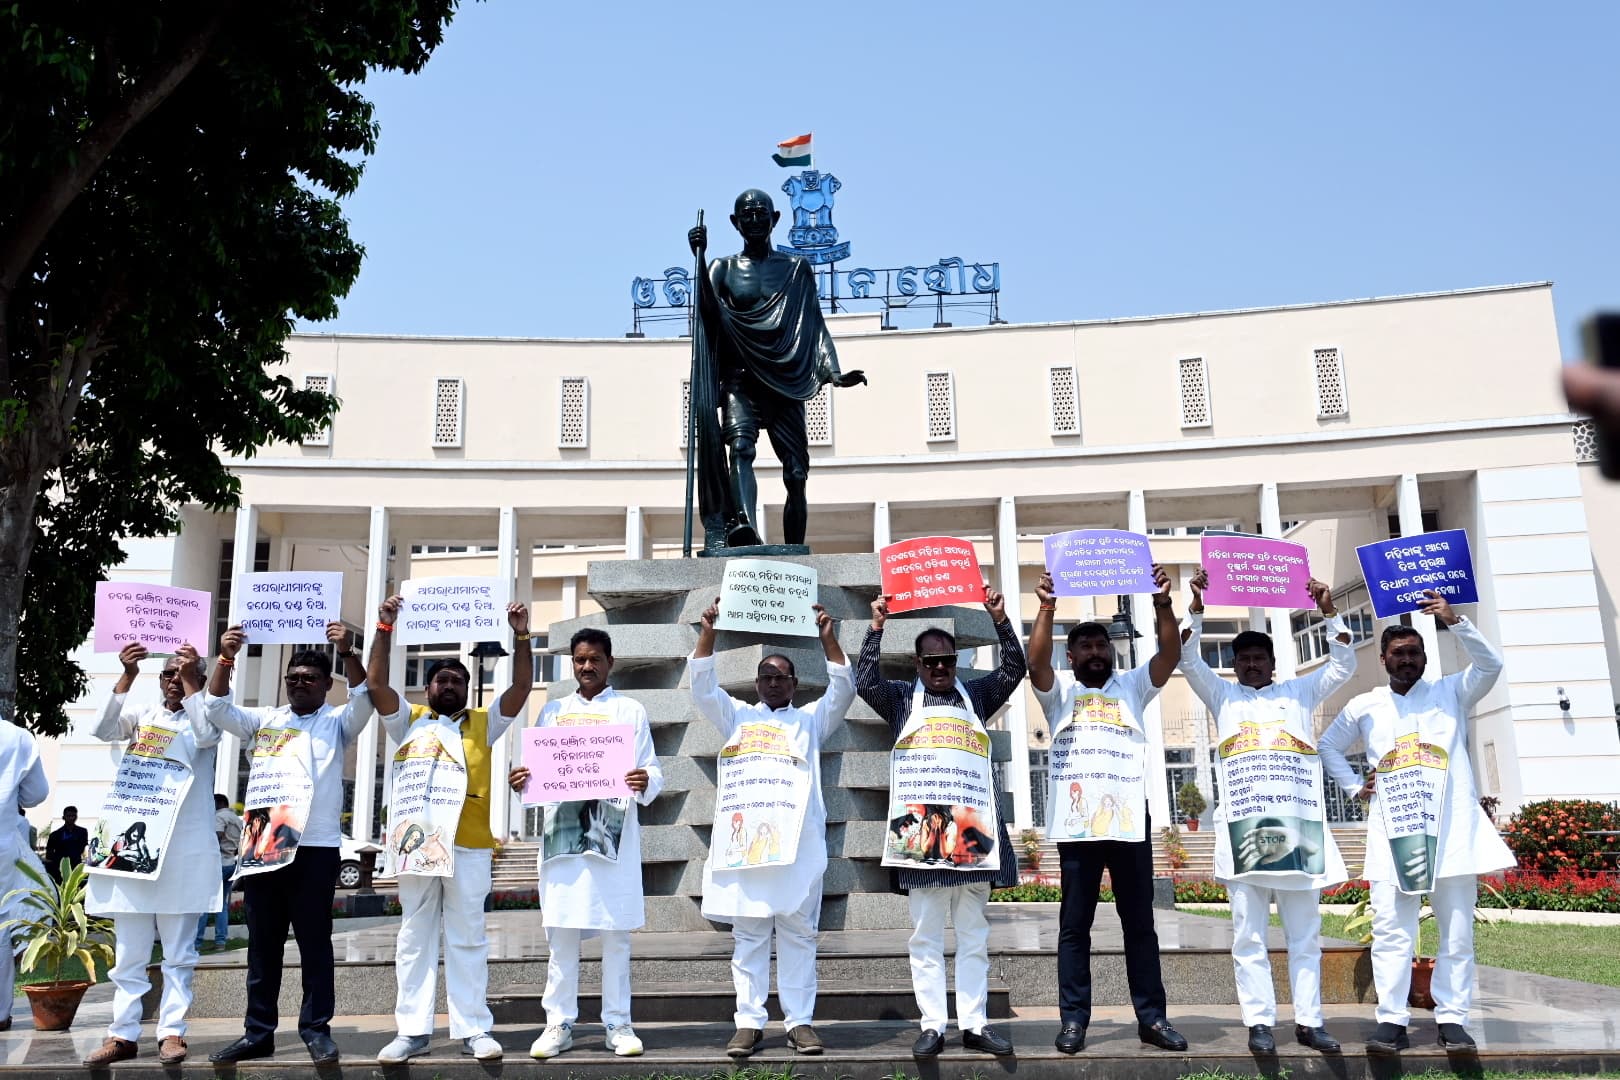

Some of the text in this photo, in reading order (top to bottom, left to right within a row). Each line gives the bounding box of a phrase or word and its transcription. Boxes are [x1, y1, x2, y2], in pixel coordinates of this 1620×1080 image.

[1098, 536, 1111, 546] ପ୍ରତି
[886, 550, 919, 564] ଦେଶରେ
[918, 545, 943, 558] ମହିଳା
[1207, 549, 1231, 560] ମହିଳା
[1257, 552, 1271, 562] ପ୍ରତି
[1384, 541, 1450, 560] ମହିଳାଙ୍କୁ ଆଗେ
[950, 557, 971, 570] ଚତୁର୍ଥ
[1397, 556, 1447, 572] ଦିଅ ସୁରକ୍ଷା
[728, 569, 812, 586] ଦେଶରେ ମହିଳା ଅପରାଧ
[915, 574, 933, 585] ଏହା
[1226, 573, 1234, 581] ଓ
[1379, 569, 1468, 591] ବିଧାନ ସଭାରେ ପରେ
[252, 582, 323, 596] ଅପରାଧୀମାନଙ୍କୁ
[1069, 579, 1098, 589] ସରକାର
[417, 585, 491, 598] ଅପରାଧୀମାନଙ୍କୁ
[788, 587, 809, 599] ଚତୁର୍ଥ
[895, 591, 912, 601] ଆମ
[913, 586, 949, 599] ଅସ୍ମିତାର
[947, 584, 964, 593] ଫଳ
[165, 596, 201, 611] ସରକାର
[246, 601, 283, 613] କଠୋର
[284, 601, 303, 612] ଦଣ୍ଡ
[411, 602, 450, 613] କଠୋର
[452, 602, 470, 612] ଦଣ୍ଡ
[750, 598, 768, 609] ଏହା
[129, 617, 146, 629] ପ୍ରତି
[727, 610, 744, 620] ଆମ
[746, 610, 779, 624] ଅସ୍ମିତାର
[779, 614, 796, 624] ଫଳ
[241, 619, 275, 633] ନାରୀଙ୍କୁ
[277, 619, 303, 629] ନ୍ୟାୟ
[406, 619, 442, 632] ନାରୀଙ୍କୁ
[444, 618, 472, 629] ନ୍ୟାୟ
[589, 735, 625, 746] ସରକାର
[557, 763, 574, 777] ପ୍ରତି
[1259, 835, 1287, 844] STOP
